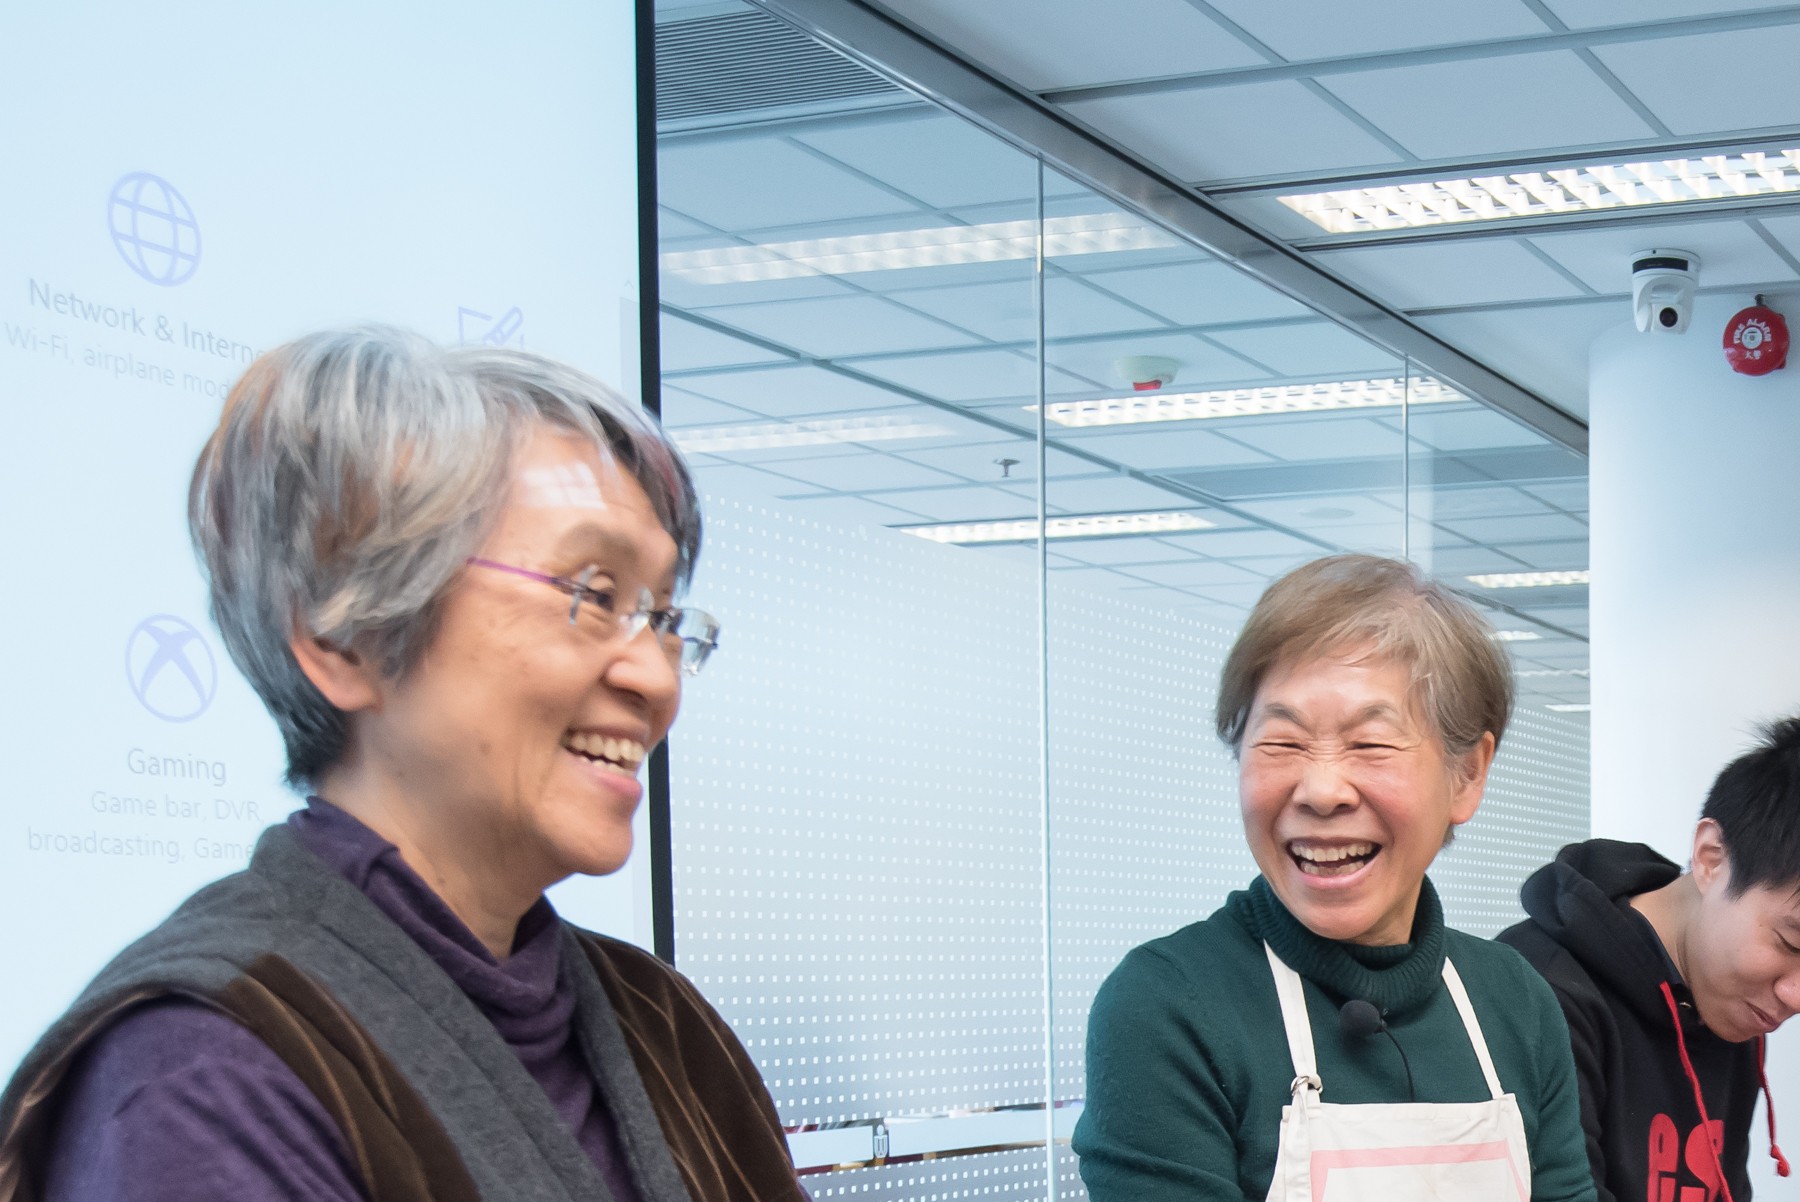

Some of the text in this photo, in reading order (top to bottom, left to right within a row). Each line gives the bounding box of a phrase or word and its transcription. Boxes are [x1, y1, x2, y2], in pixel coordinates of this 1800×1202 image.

[29, 277, 146, 336] Network
[154, 314, 176, 345] &
[4, 321, 75, 365] Wi-Fi,
[83, 343, 176, 387] airplane
[127, 747, 227, 787] Gaming
[90, 790, 157, 816] Game
[164, 793, 207, 821] bar,
[27, 826, 185, 864] broadcasting,
